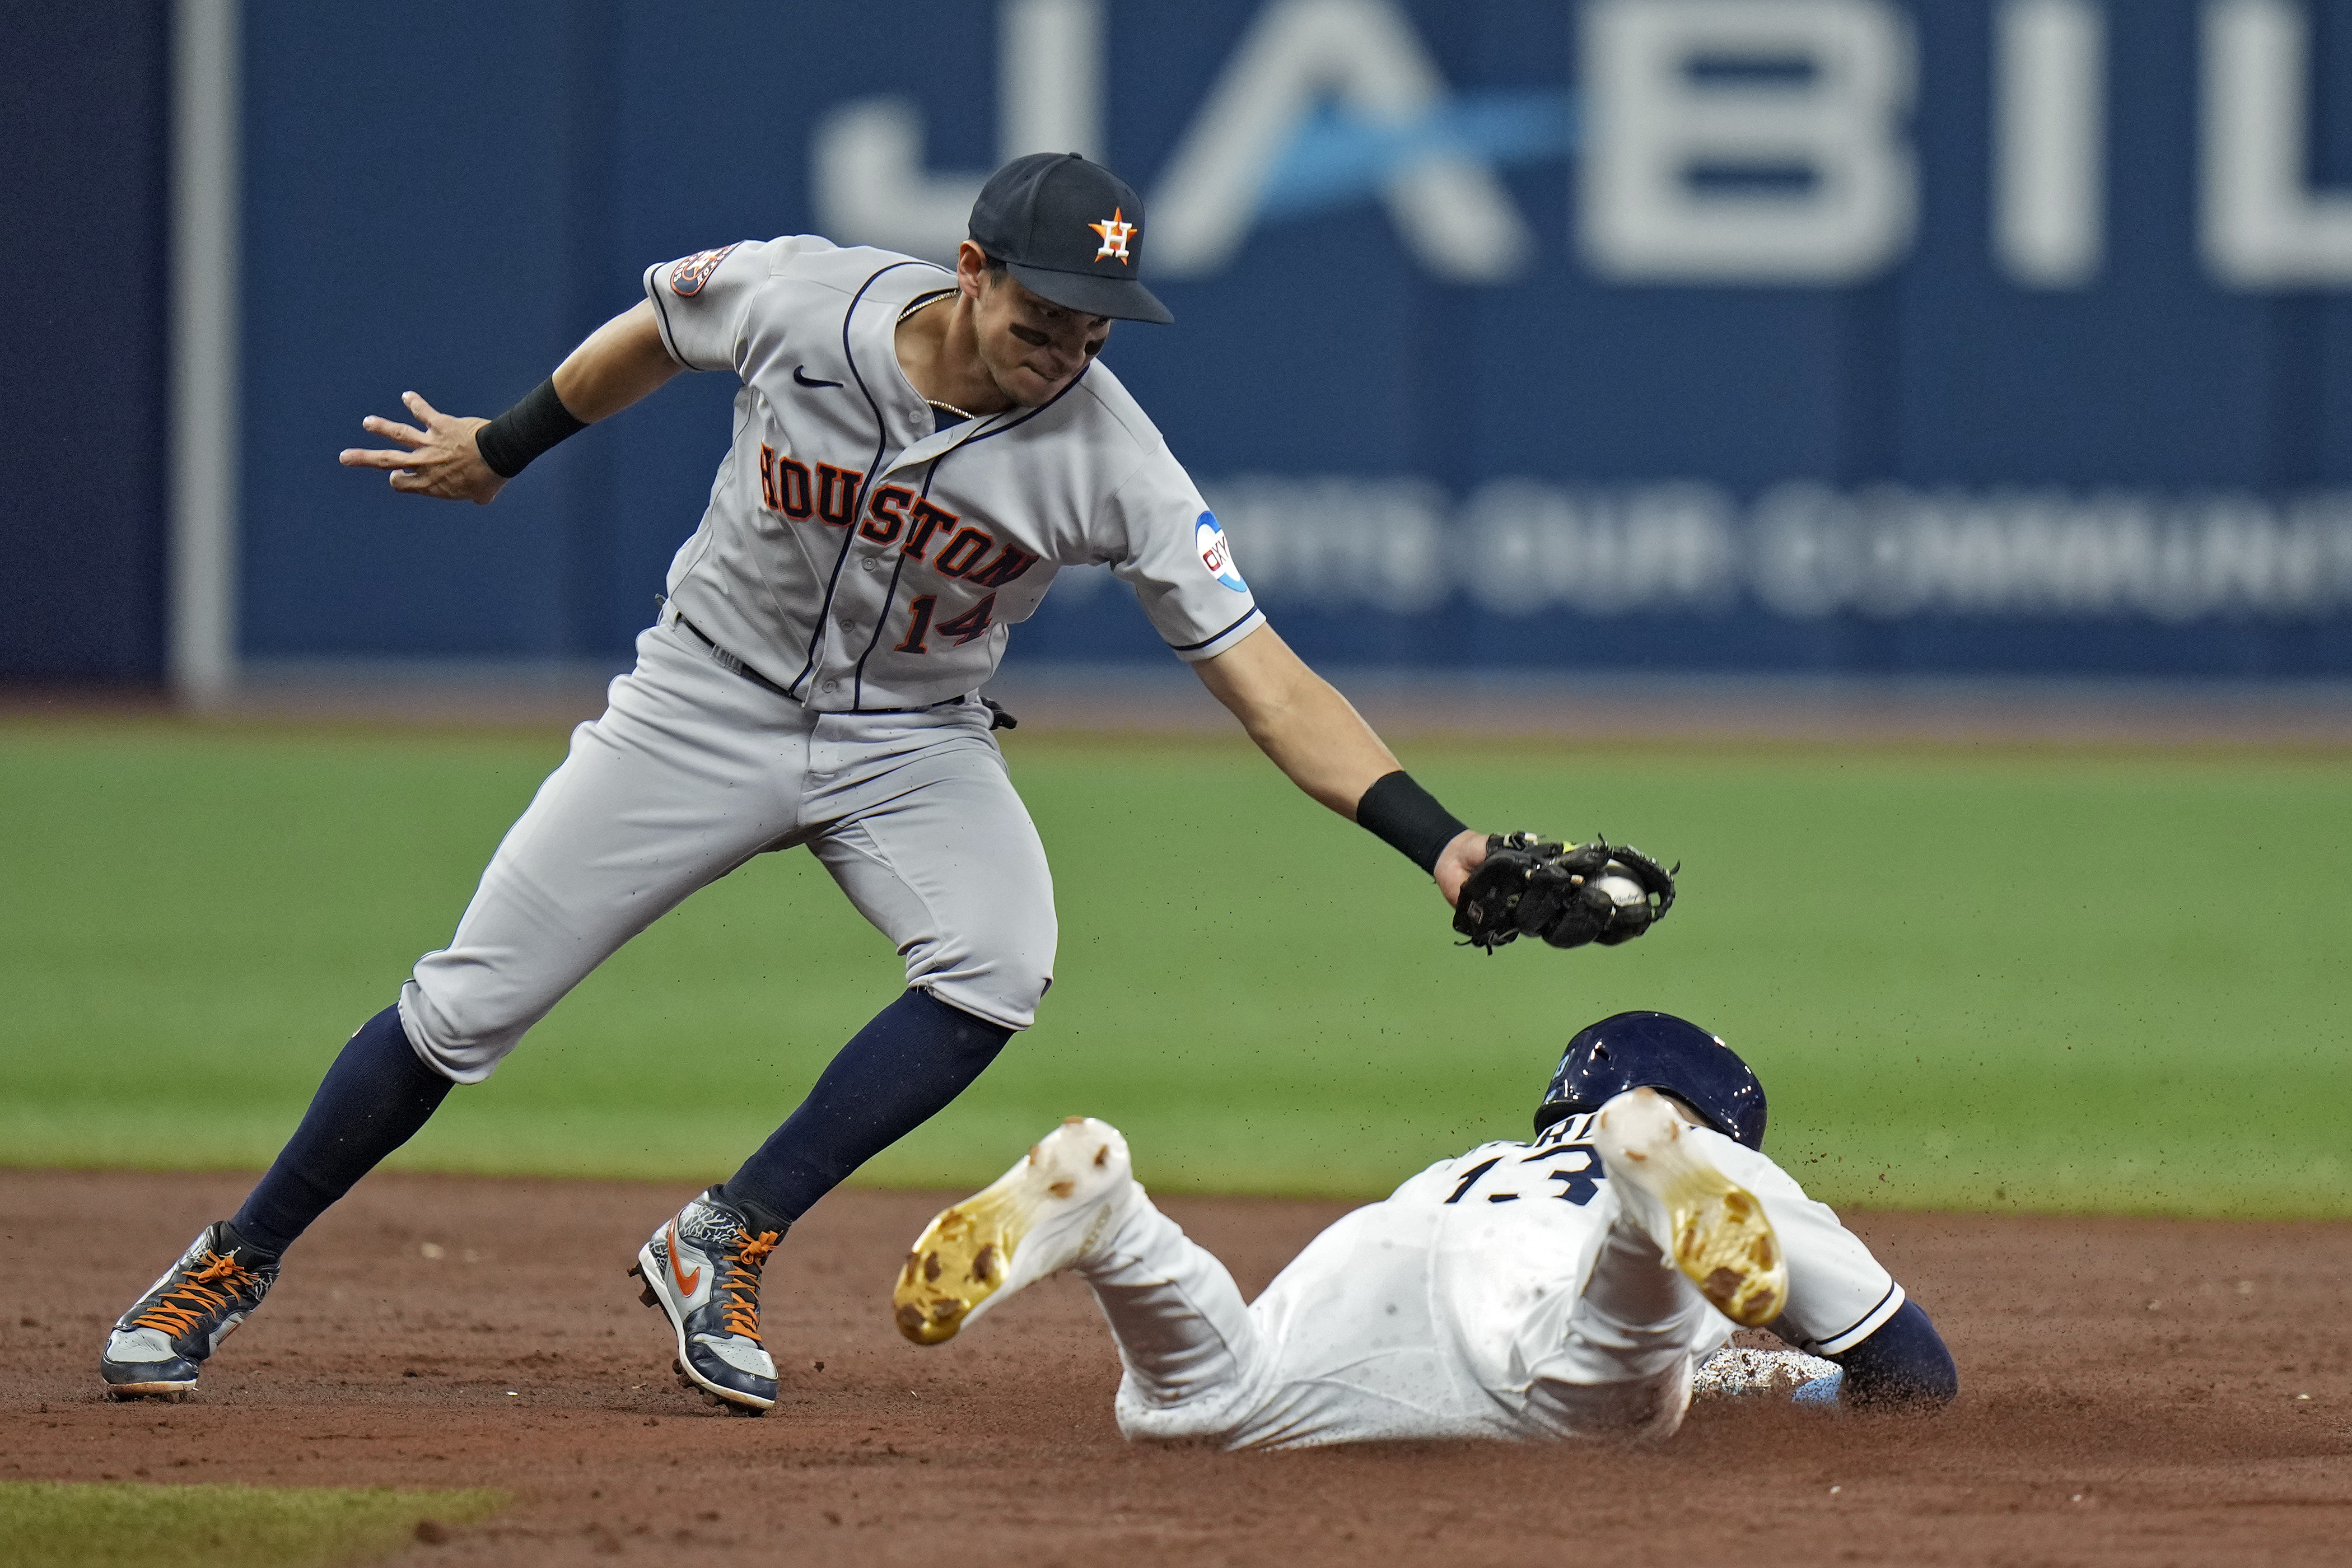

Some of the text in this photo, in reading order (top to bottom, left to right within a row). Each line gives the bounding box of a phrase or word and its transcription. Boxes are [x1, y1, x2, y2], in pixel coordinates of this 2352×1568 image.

[812, 0, 2352, 284] JABIL
[1098, 219, 1132, 258] H
[760, 441, 1040, 588] HOUSTON
[1203, 536, 1229, 571] OXY
[894, 592, 996, 654] 14
